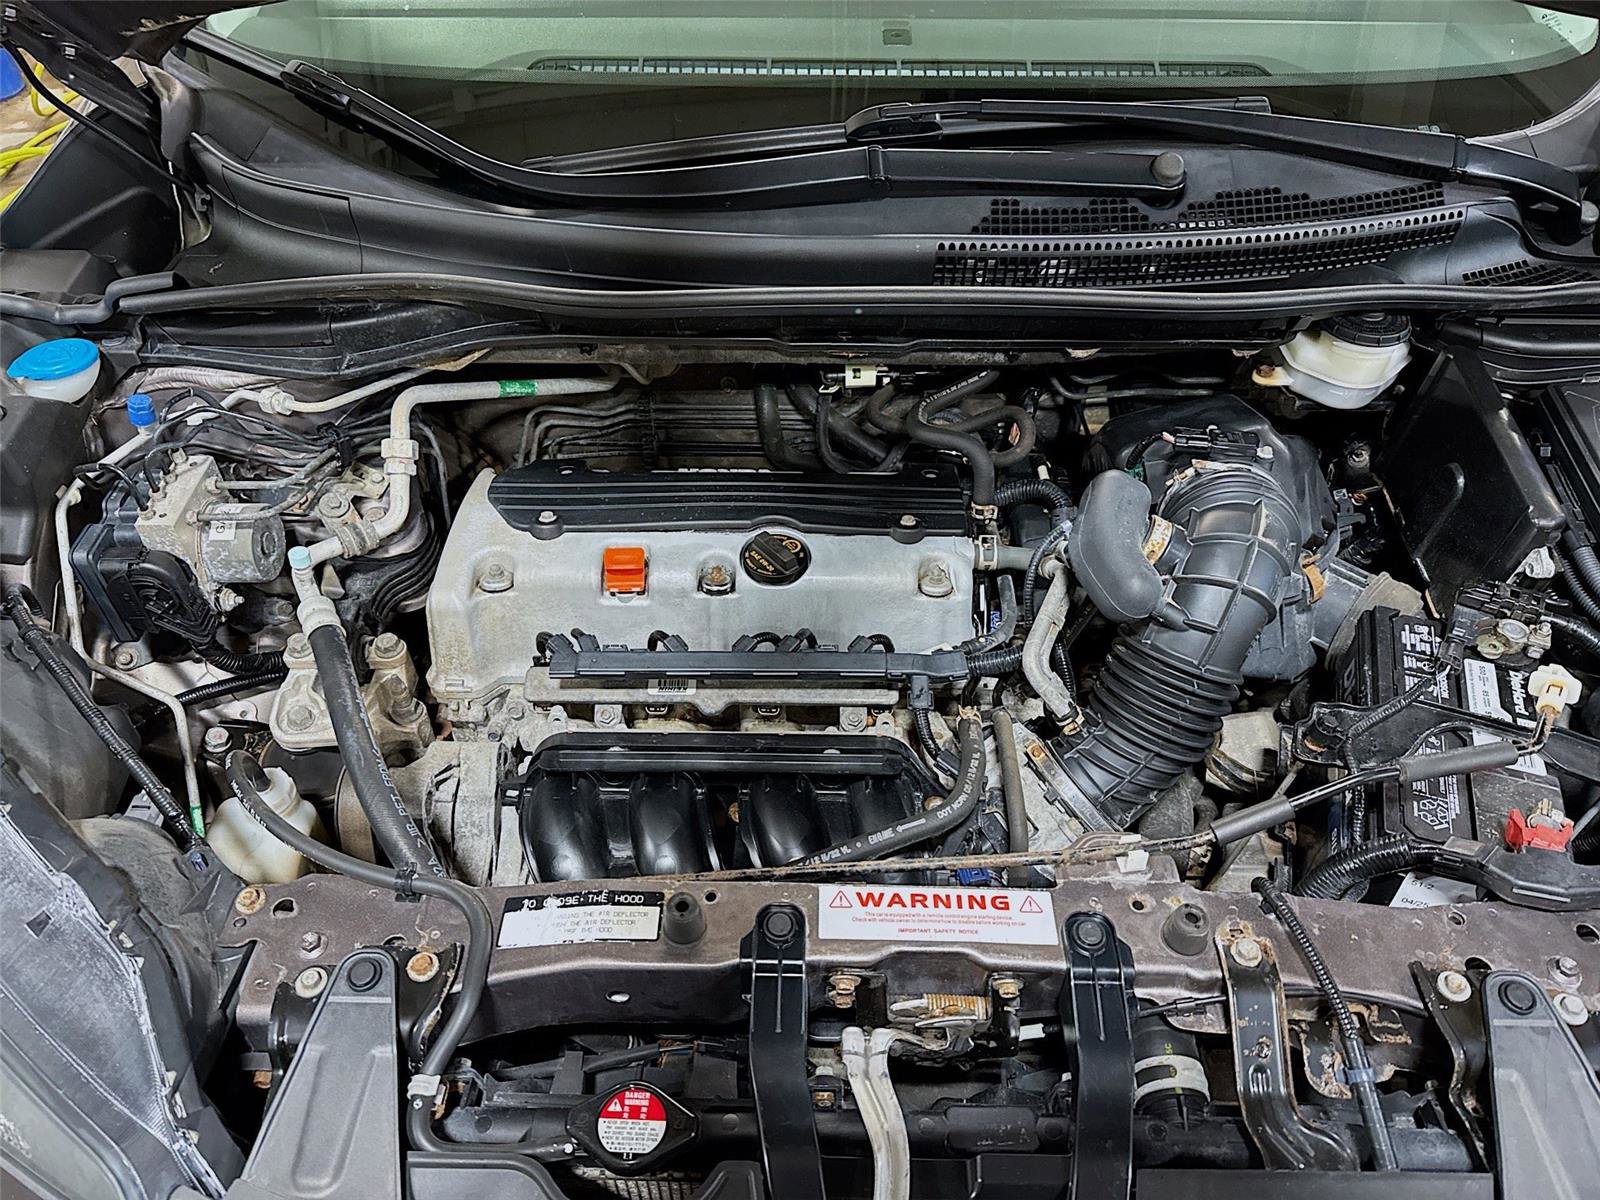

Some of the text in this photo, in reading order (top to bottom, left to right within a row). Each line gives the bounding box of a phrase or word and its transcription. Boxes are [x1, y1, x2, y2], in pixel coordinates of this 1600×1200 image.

[1508, 670, 1530, 716] DieHard
[588, 894, 609, 903] THE
[615, 894, 644, 903] HOOD
[855, 891, 1010, 911] WARNING
[625, 1091, 651, 1099] DANGER
